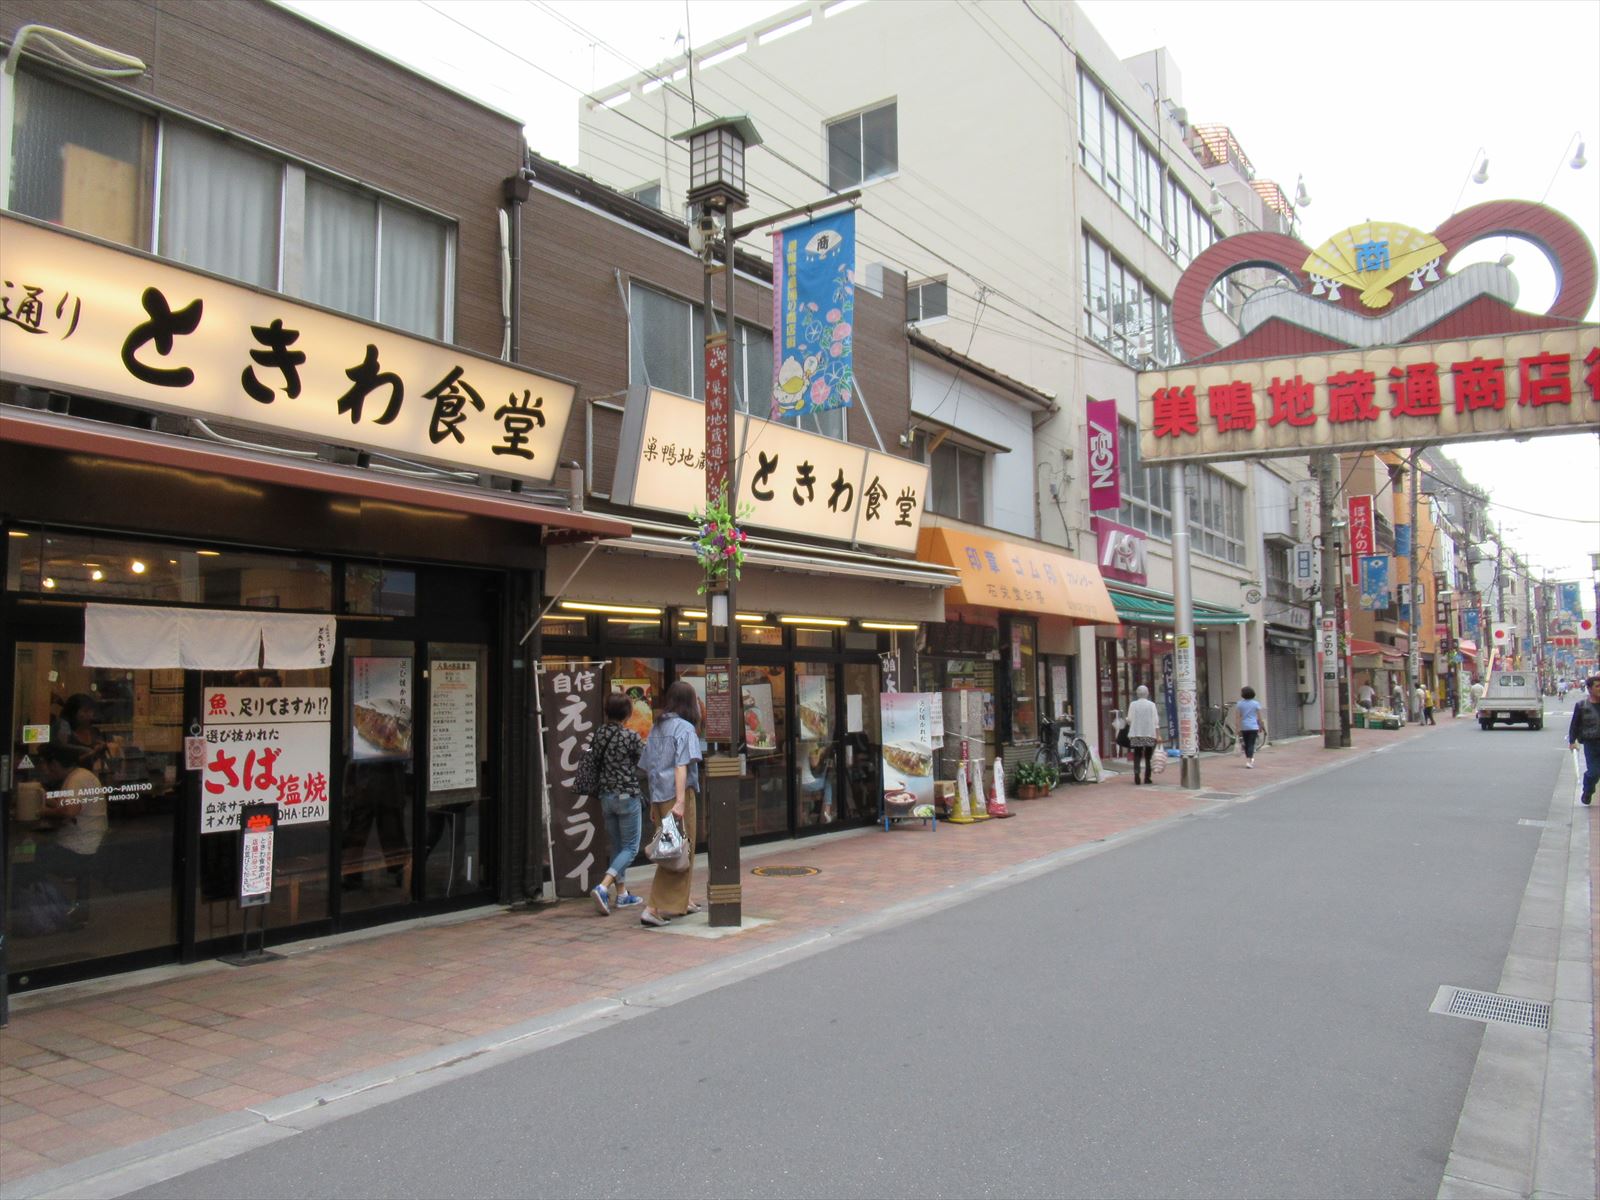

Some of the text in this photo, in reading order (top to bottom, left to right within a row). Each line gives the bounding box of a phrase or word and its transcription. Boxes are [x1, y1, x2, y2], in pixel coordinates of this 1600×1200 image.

[1354, 240, 1390, 272] 商
[0, 280, 546, 460] 通り ときわ食堂
[751, 451, 917, 528] ときわ食堂
[1354, 506, 1369, 553] ほけんの
[552, 671, 596, 694] 自信
[206, 728, 279, 744] 選び抜かれた
[206, 798, 265, 815] 血液サラサ
